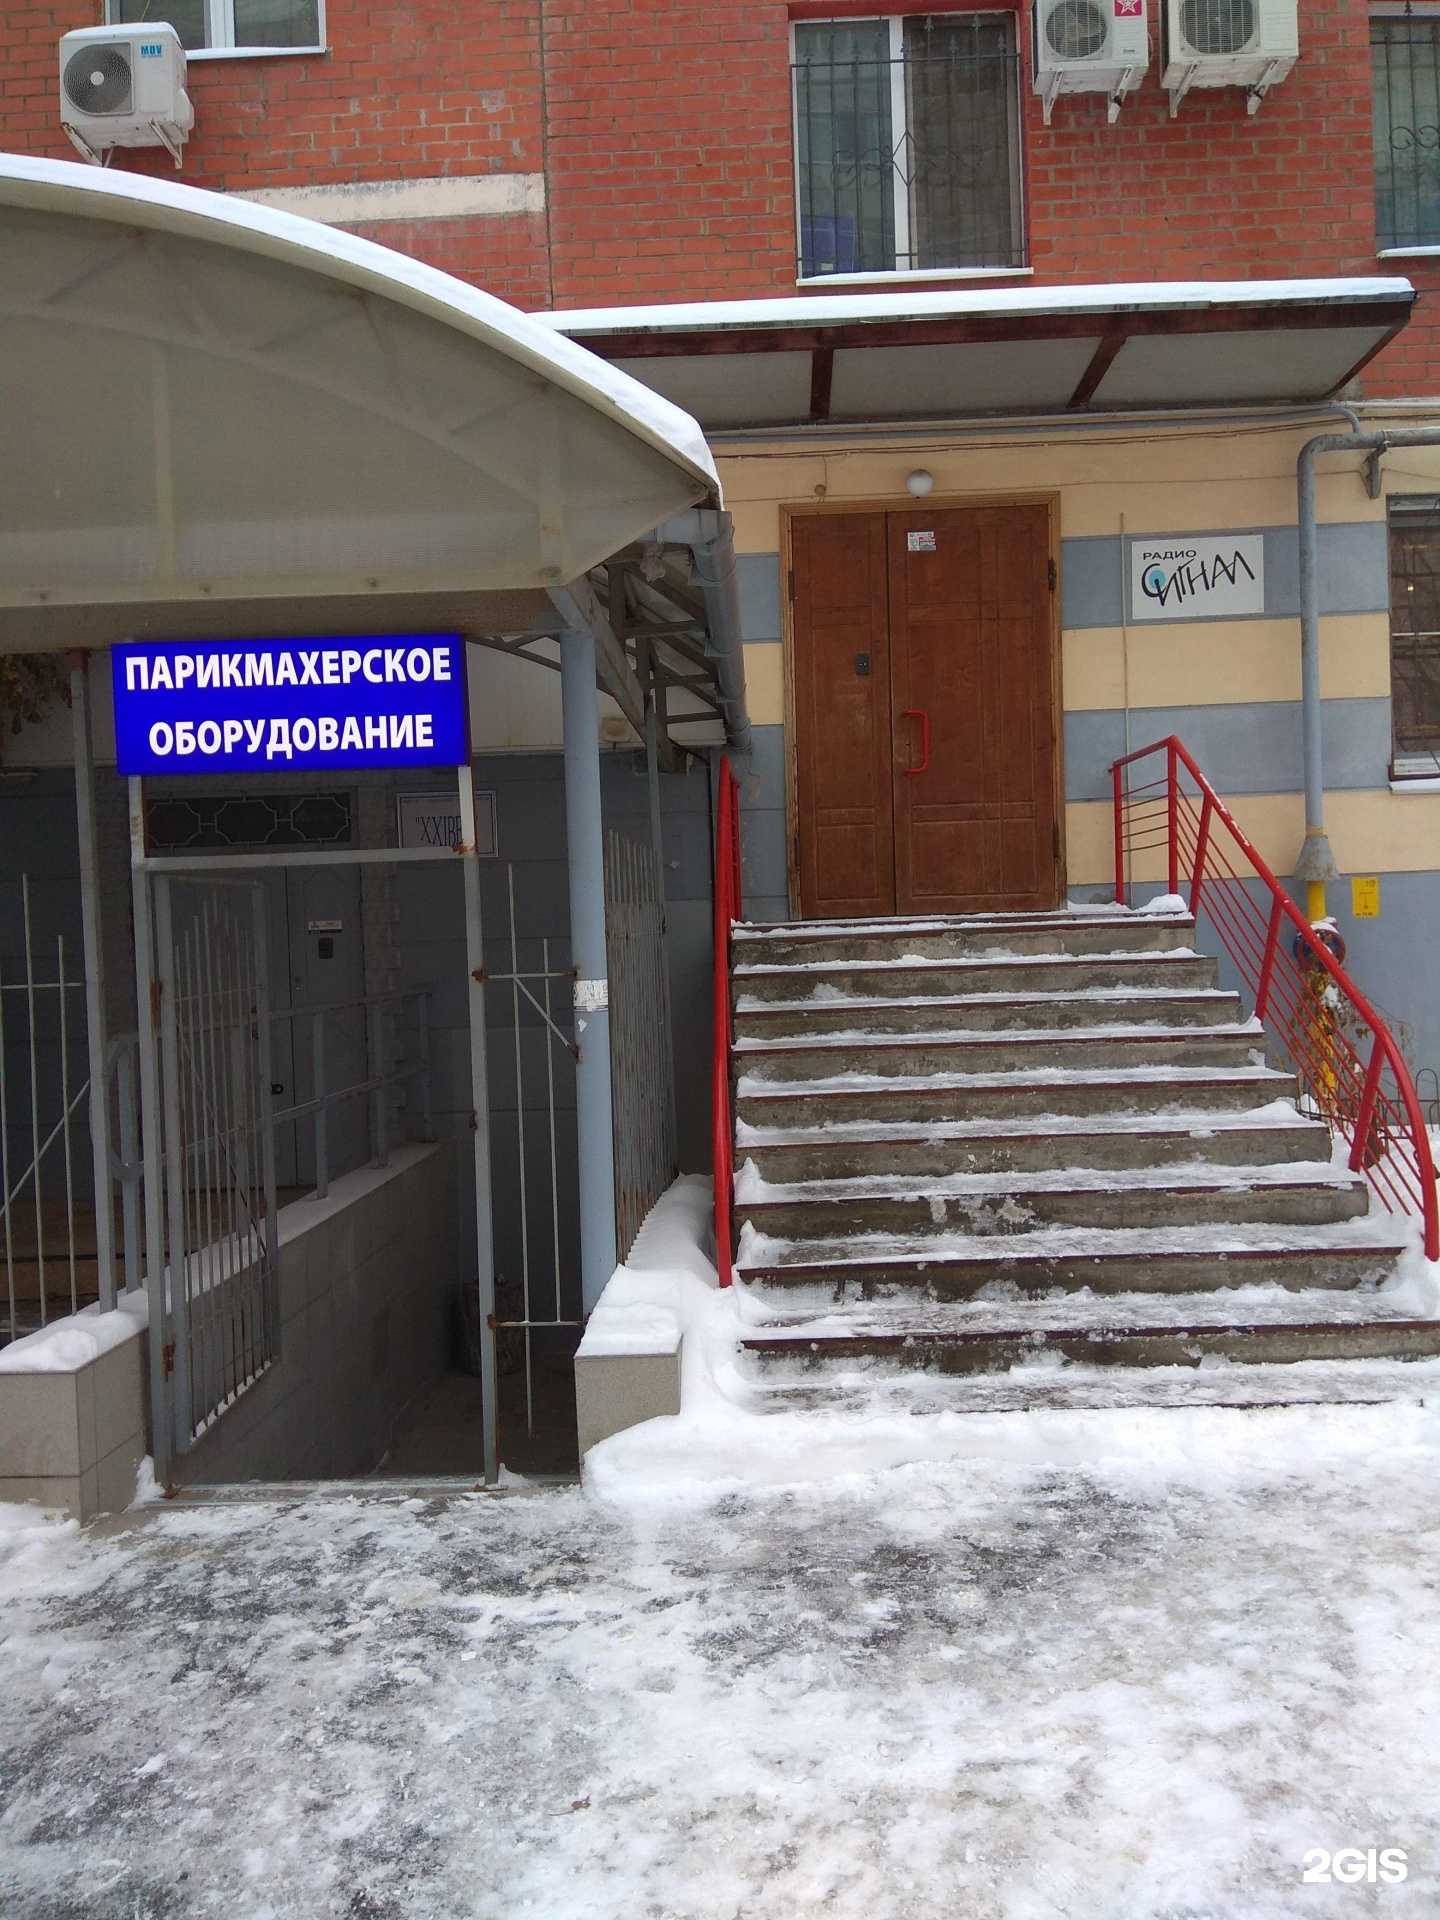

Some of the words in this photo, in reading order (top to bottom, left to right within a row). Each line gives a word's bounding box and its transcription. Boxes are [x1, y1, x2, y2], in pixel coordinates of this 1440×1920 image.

[140, 44, 162, 55] MDV
[1143, 549, 1197, 560] РАДИО
[1141, 550, 1255, 607] СИГНАЛ
[125, 647, 451, 690] ПАРИКМАХЕРСКОЕ
[149, 714, 434, 760] ОБОРУДОВАНИЕ
